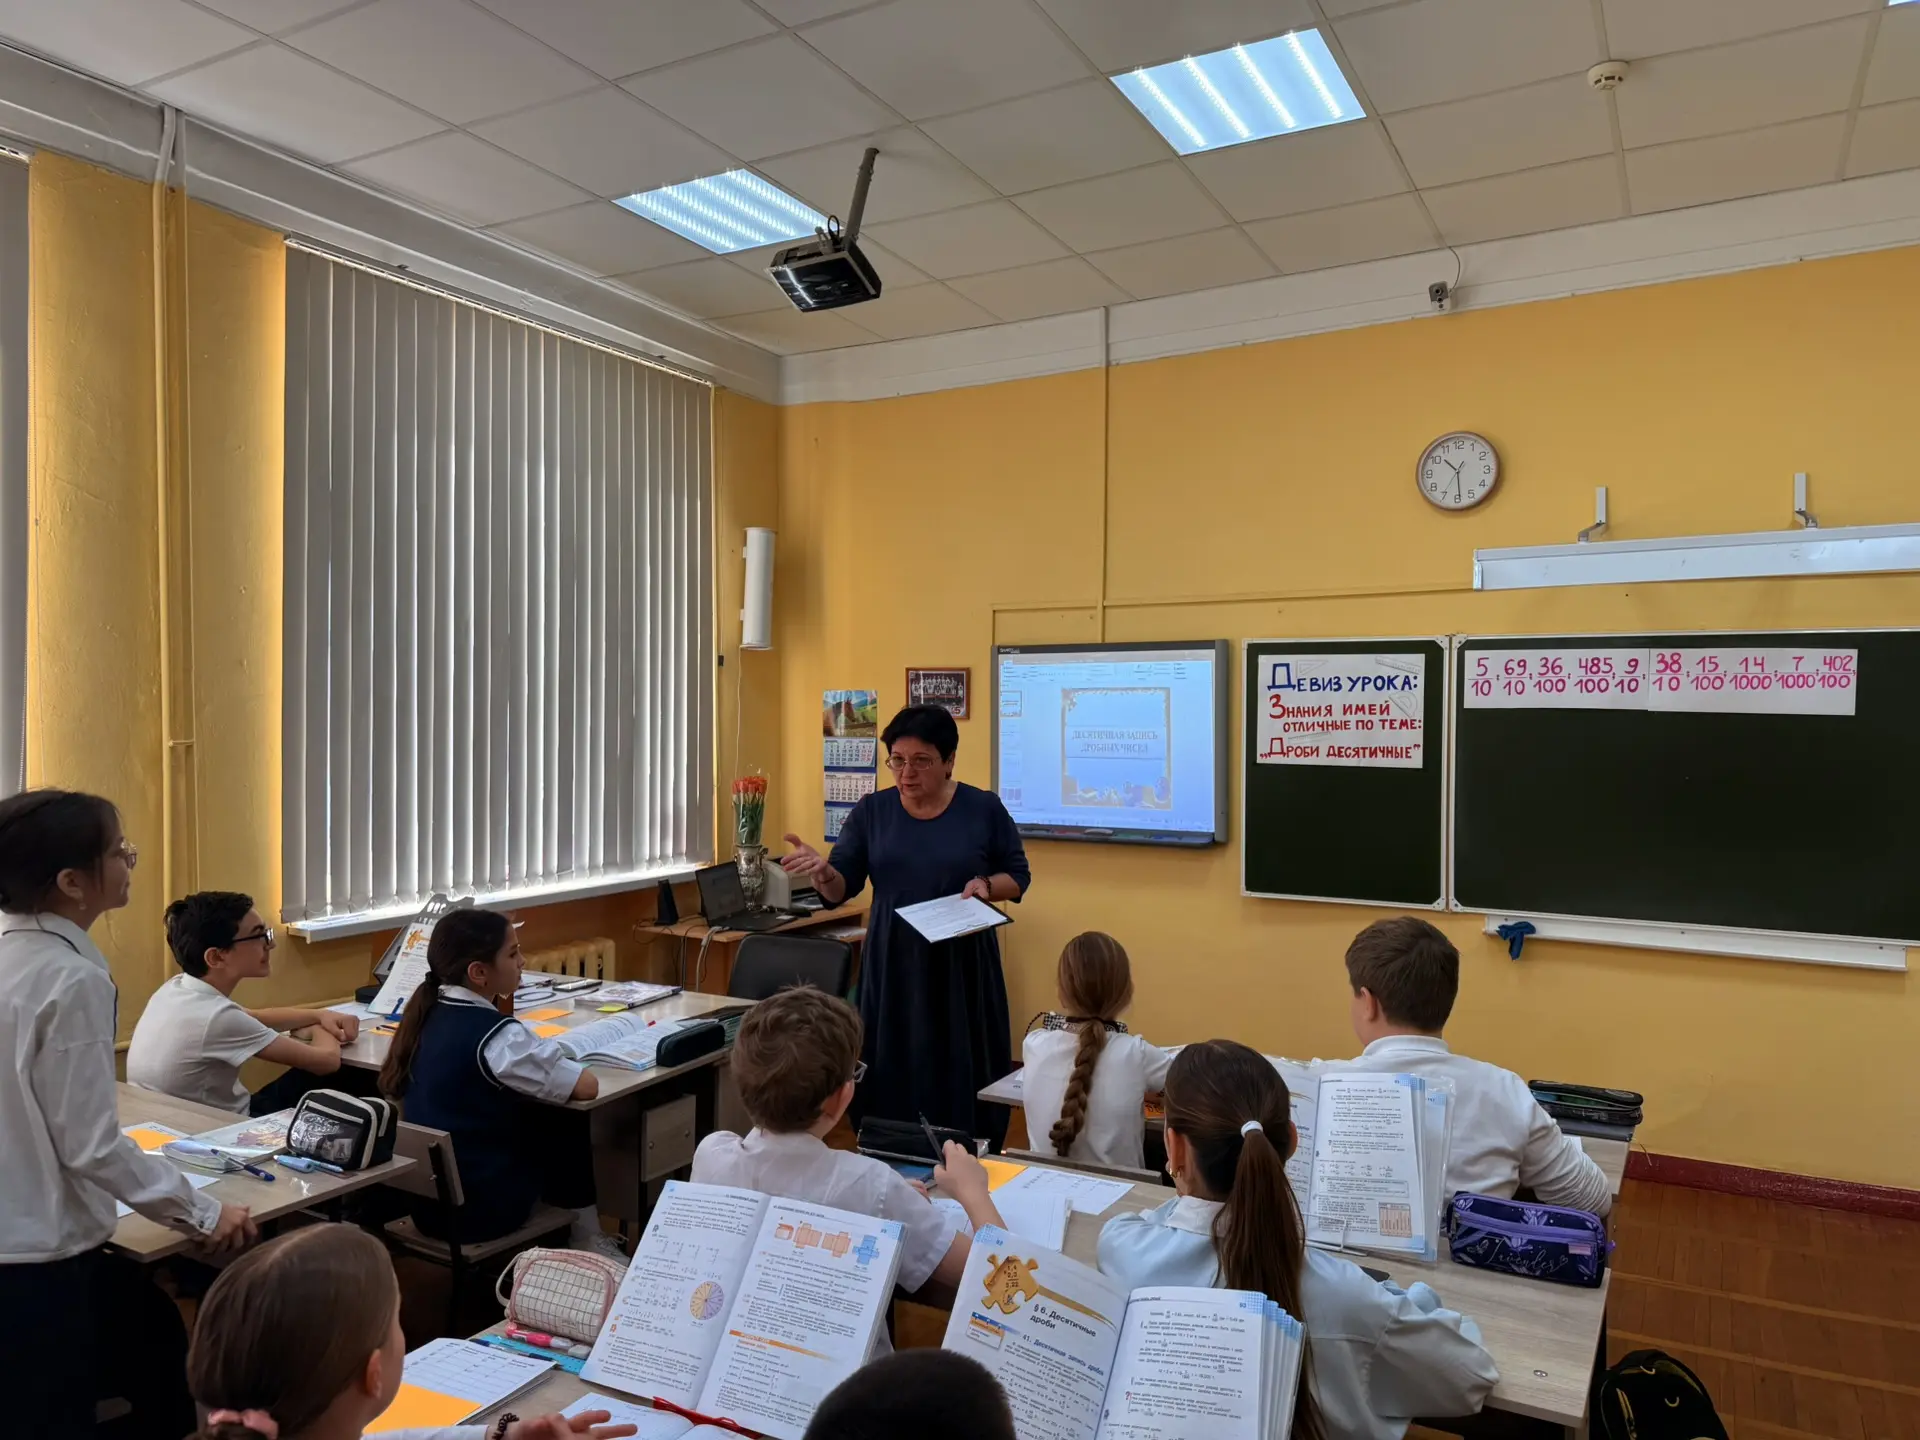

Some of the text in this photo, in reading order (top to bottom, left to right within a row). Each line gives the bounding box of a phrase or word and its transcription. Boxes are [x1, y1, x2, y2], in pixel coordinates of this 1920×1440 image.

[1441, 445, 1450, 454] 11
[1452, 440, 1464, 450] 12
[1470, 442, 1474, 452] 1
[1431, 456, 1441, 465] 10
[1479, 452, 1486, 461] 2
[1426, 470, 1433, 478] 9
[1484, 465, 1491, 474] 3
[1430, 482, 1437, 492] 8
[1479, 479, 1486, 487] 4
[1441, 491, 1447, 500] 7
[1454, 494, 1461, 504] 6
[1468, 490, 1475, 499] 5
[1476, 652, 1854, 676] 5 69 36 485 9 38 15 14 7 402
[1267, 662, 1418, 692] ДЕВИЗ УРОКА:
[1471, 673, 1851, 696] 10 10 100 100 10 10 100 1000 1000 100
[1269, 694, 1391, 720] ЗНАНИЯ ИМЕЙ
[1283, 719, 1422, 733] ОТЛИЧНЫЕ ПО ТЕМЕ:
[1072, 730, 1158, 740] ДЕСЯТИЧНАЯ ЗАПИСЬ
[1030, 1315, 1056, 1330] дроби
[1040, 1306, 1048, 1315] 6.
[1049, 1310, 1096, 1337] Десятичные
[1022, 1334, 1032, 1342] 41.
[1034, 1339, 1066, 1357] Десятичная
